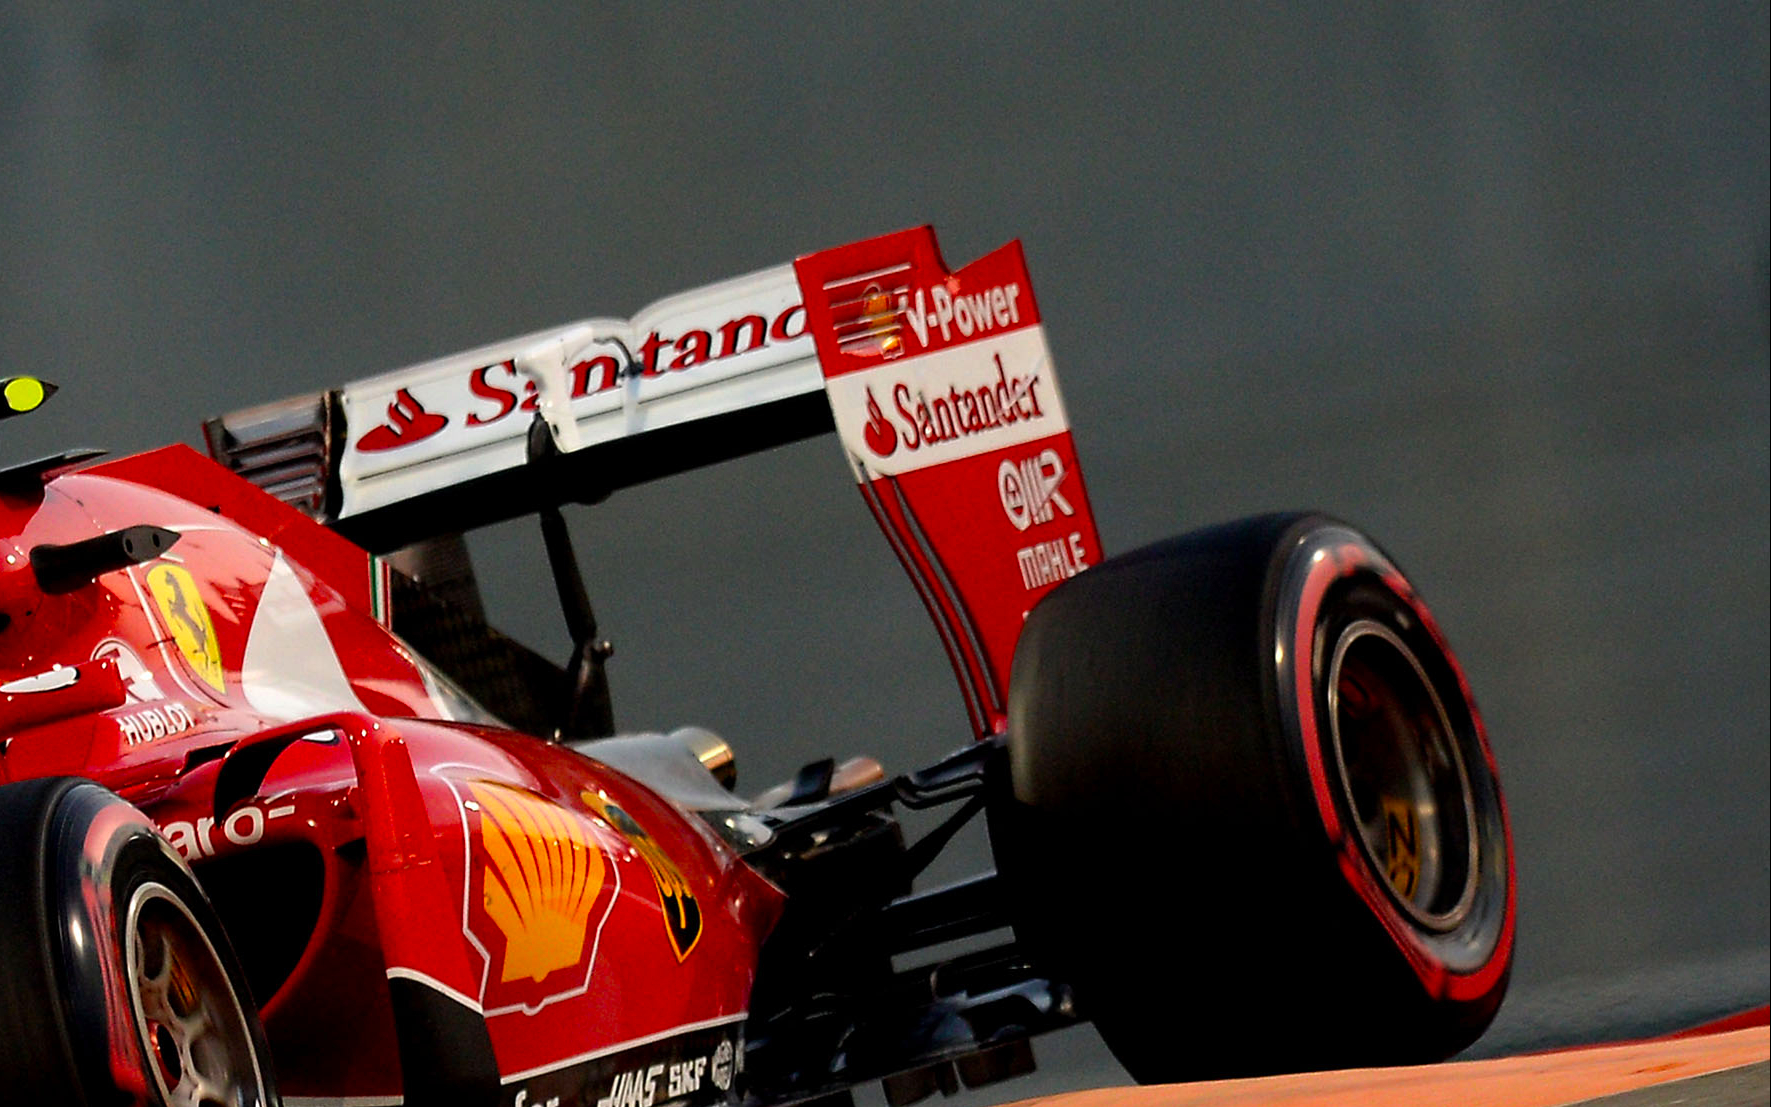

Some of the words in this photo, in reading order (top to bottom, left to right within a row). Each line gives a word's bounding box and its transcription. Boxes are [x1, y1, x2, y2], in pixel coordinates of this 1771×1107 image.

[898, 282, 1020, 347] V-Power
[893, 352, 1043, 449] Santander
[1017, 532, 1090, 590] MAHLE
[116, 703, 195, 746] HUBLOT
[668, 1056, 707, 1098] SKF
